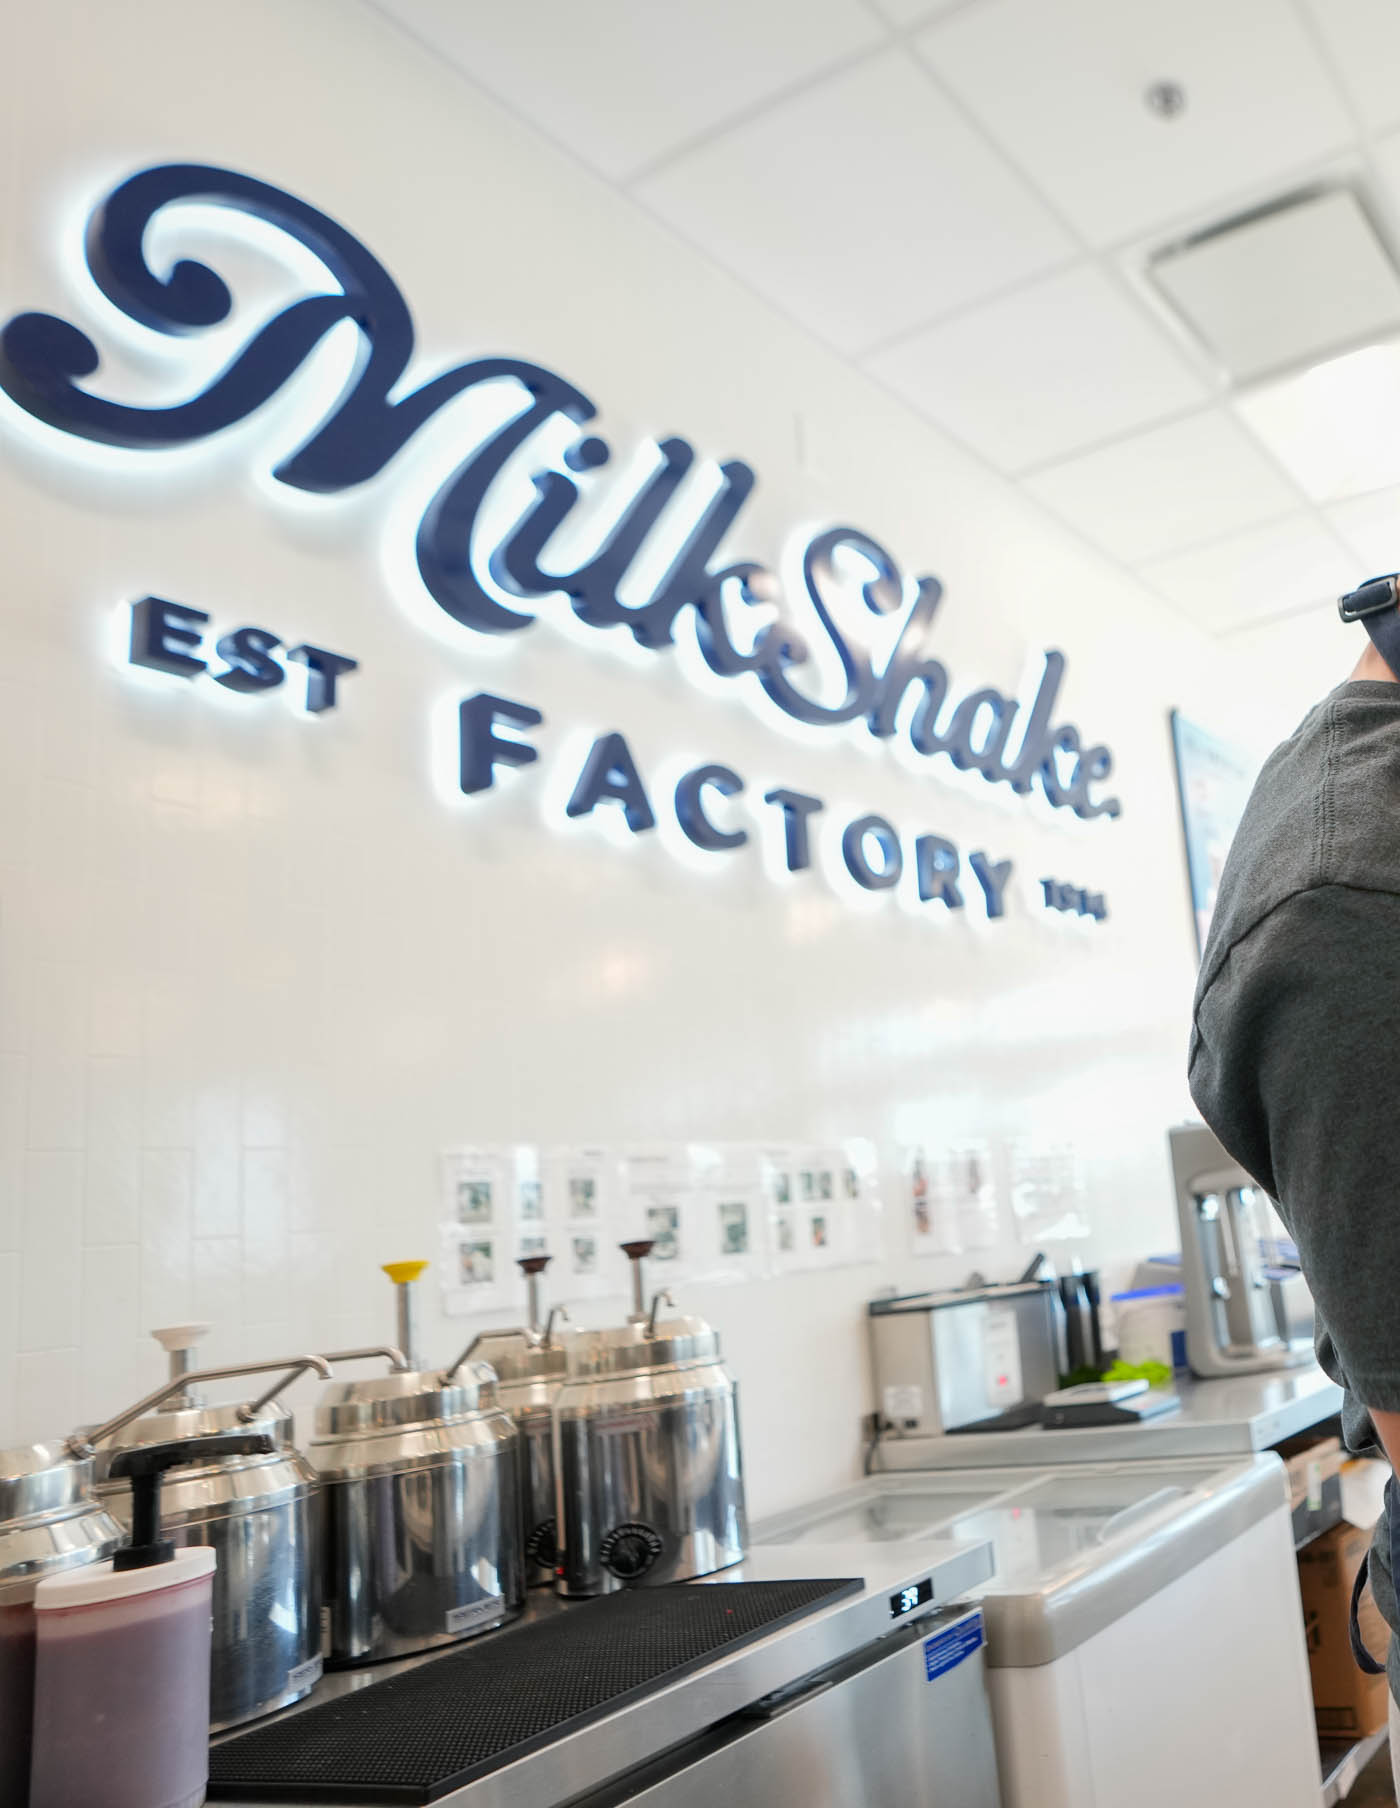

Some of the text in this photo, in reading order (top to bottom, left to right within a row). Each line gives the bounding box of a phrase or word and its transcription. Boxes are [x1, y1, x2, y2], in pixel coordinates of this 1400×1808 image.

[0, 163, 1122, 821] MilkShake
[128, 596, 358, 713] EST
[459, 691, 1013, 919] FACTORY
